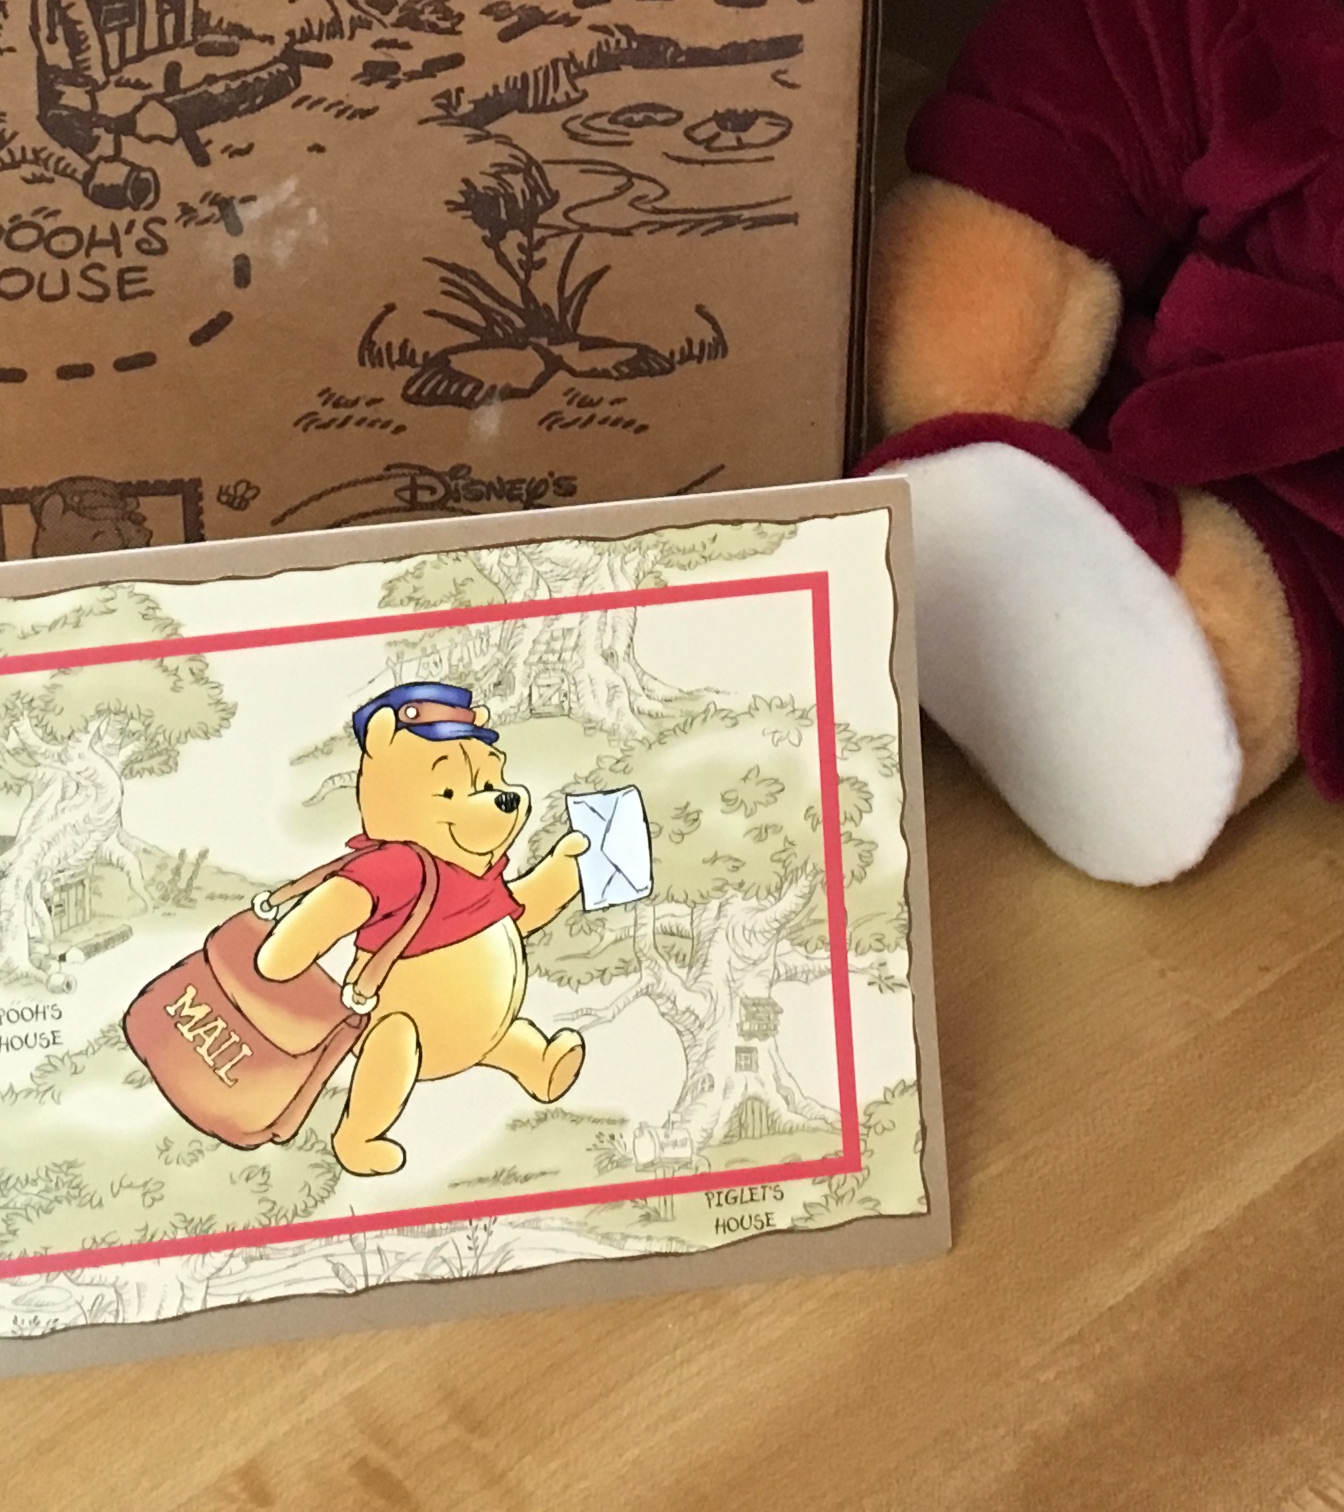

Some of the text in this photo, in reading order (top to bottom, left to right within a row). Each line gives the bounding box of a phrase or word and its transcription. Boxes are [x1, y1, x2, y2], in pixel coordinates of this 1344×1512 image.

[162, 982, 254, 1088] MAIL
[704, 1184, 785, 1209] PIGLET'S
[714, 1211, 777, 1236] HOUSE
